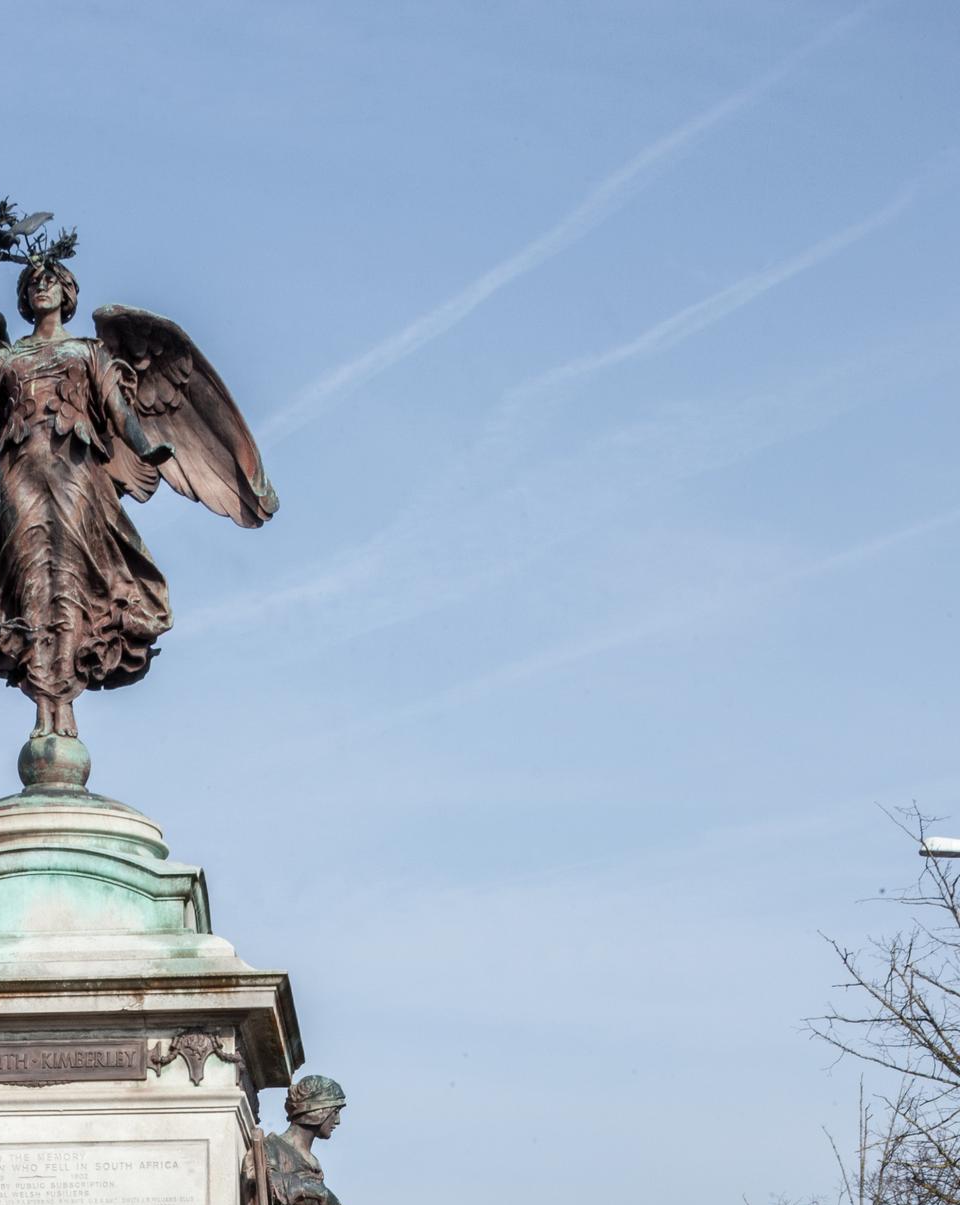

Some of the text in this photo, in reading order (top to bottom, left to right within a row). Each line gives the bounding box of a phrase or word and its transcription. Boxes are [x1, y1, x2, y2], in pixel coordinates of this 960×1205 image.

[41, 1050, 137, 1069] KIMBERLEY
[10, 1153, 31, 1162] THE
[37, 1152, 85, 1161] MEMORY
[11, 1163, 38, 1173] WHO
[45, 1163, 70, 1172] FELL
[76, 1162, 88, 1171] IN
[95, 1161, 133, 1171] SOUTH
[139, 1160, 180, 1170] AFRICA
[15, 1182, 46, 1190] PUBLIC
[50, 1181, 115, 1189] SUBSCRIPTION
